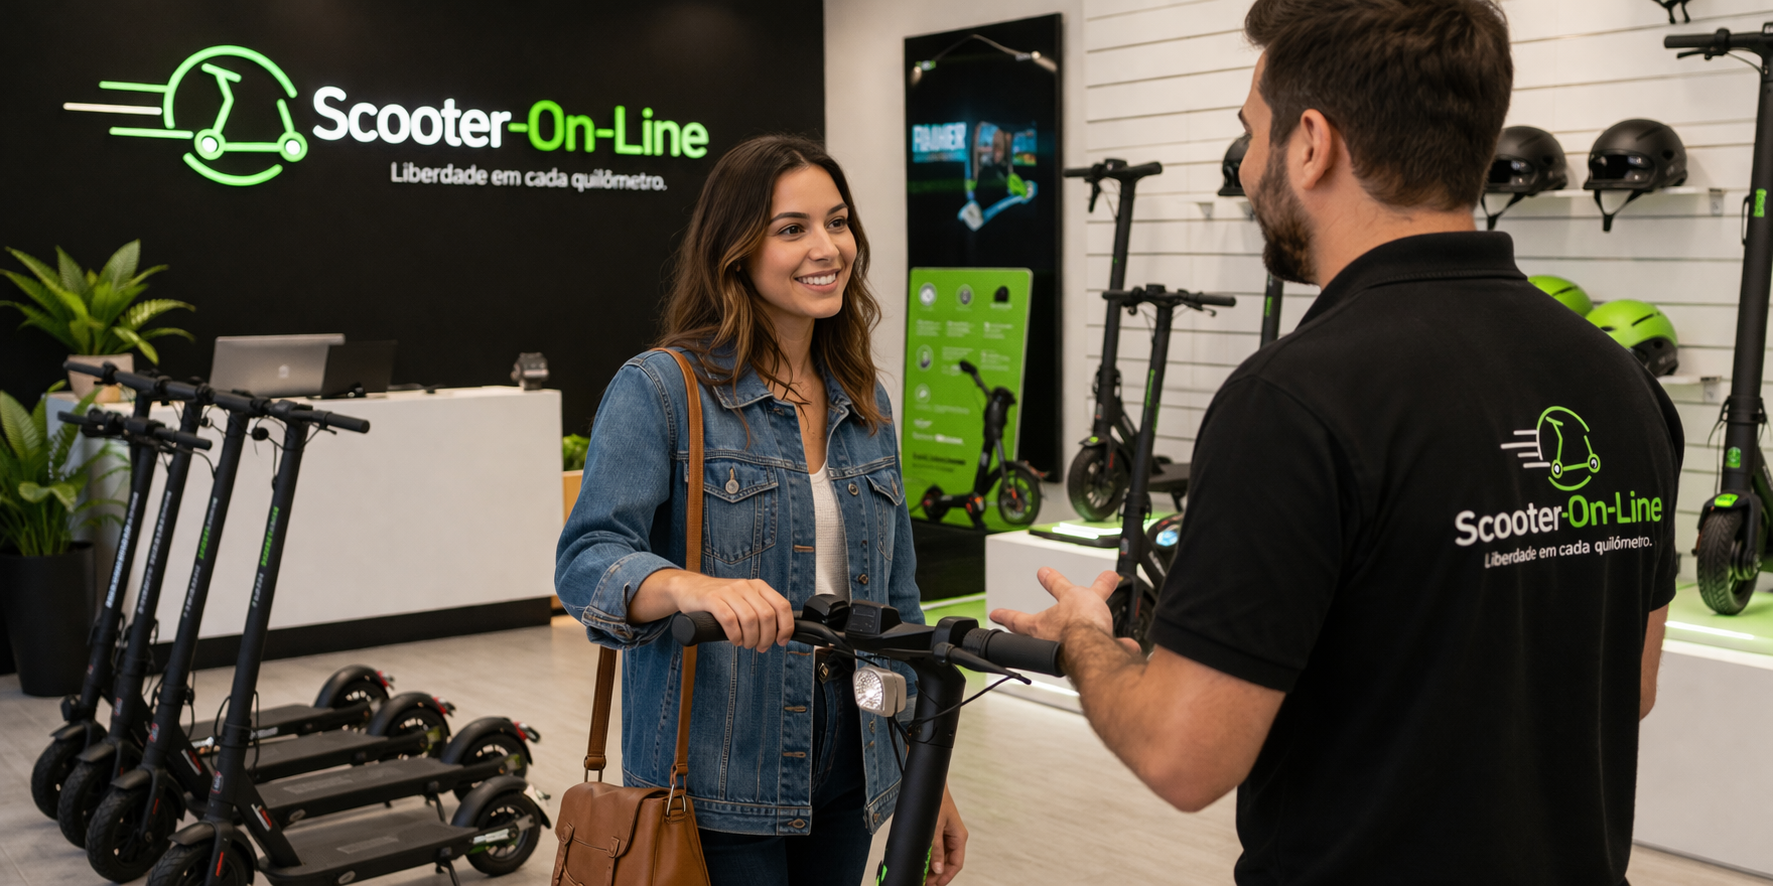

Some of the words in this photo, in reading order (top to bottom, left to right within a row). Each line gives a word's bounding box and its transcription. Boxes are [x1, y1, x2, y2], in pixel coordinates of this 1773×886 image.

[312, 86, 709, 158] Scooter-On-Line
[391, 162, 488, 185] Liberdade
[491, 169, 522, 186] em
[524, 167, 569, 187] cada
[1455, 491, 1662, 547] Scooter-On-Line
[1484, 546, 1537, 569] Liberdade
[1539, 544, 1557, 560] em
[1559, 540, 1590, 556] cada
